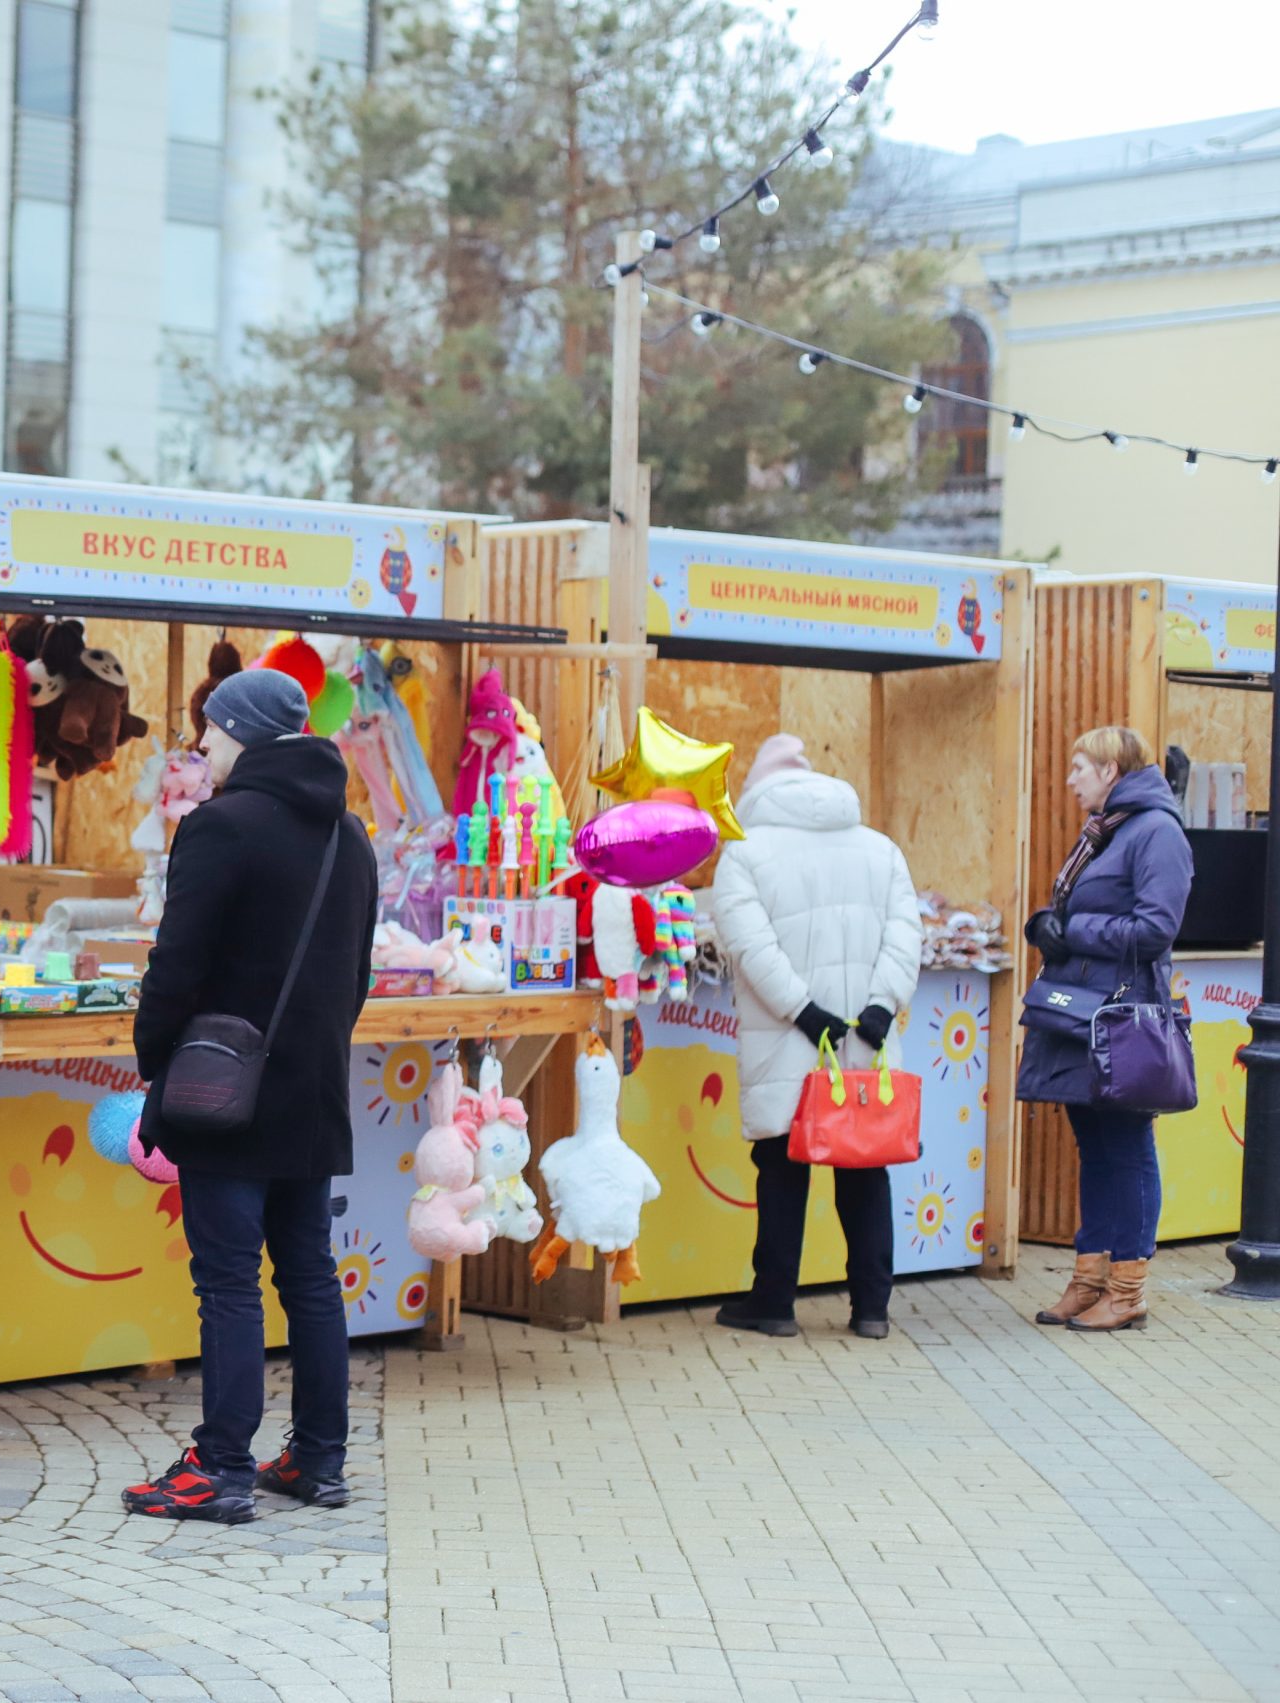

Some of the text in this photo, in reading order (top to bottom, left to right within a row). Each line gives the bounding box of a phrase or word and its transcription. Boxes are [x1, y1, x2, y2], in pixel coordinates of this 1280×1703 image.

[83, 532, 288, 569] ВКУС ДЕТСТВА
[711, 580, 919, 616] ЦЕНТРАЛЬНЫЙ МЯСНОЙ
